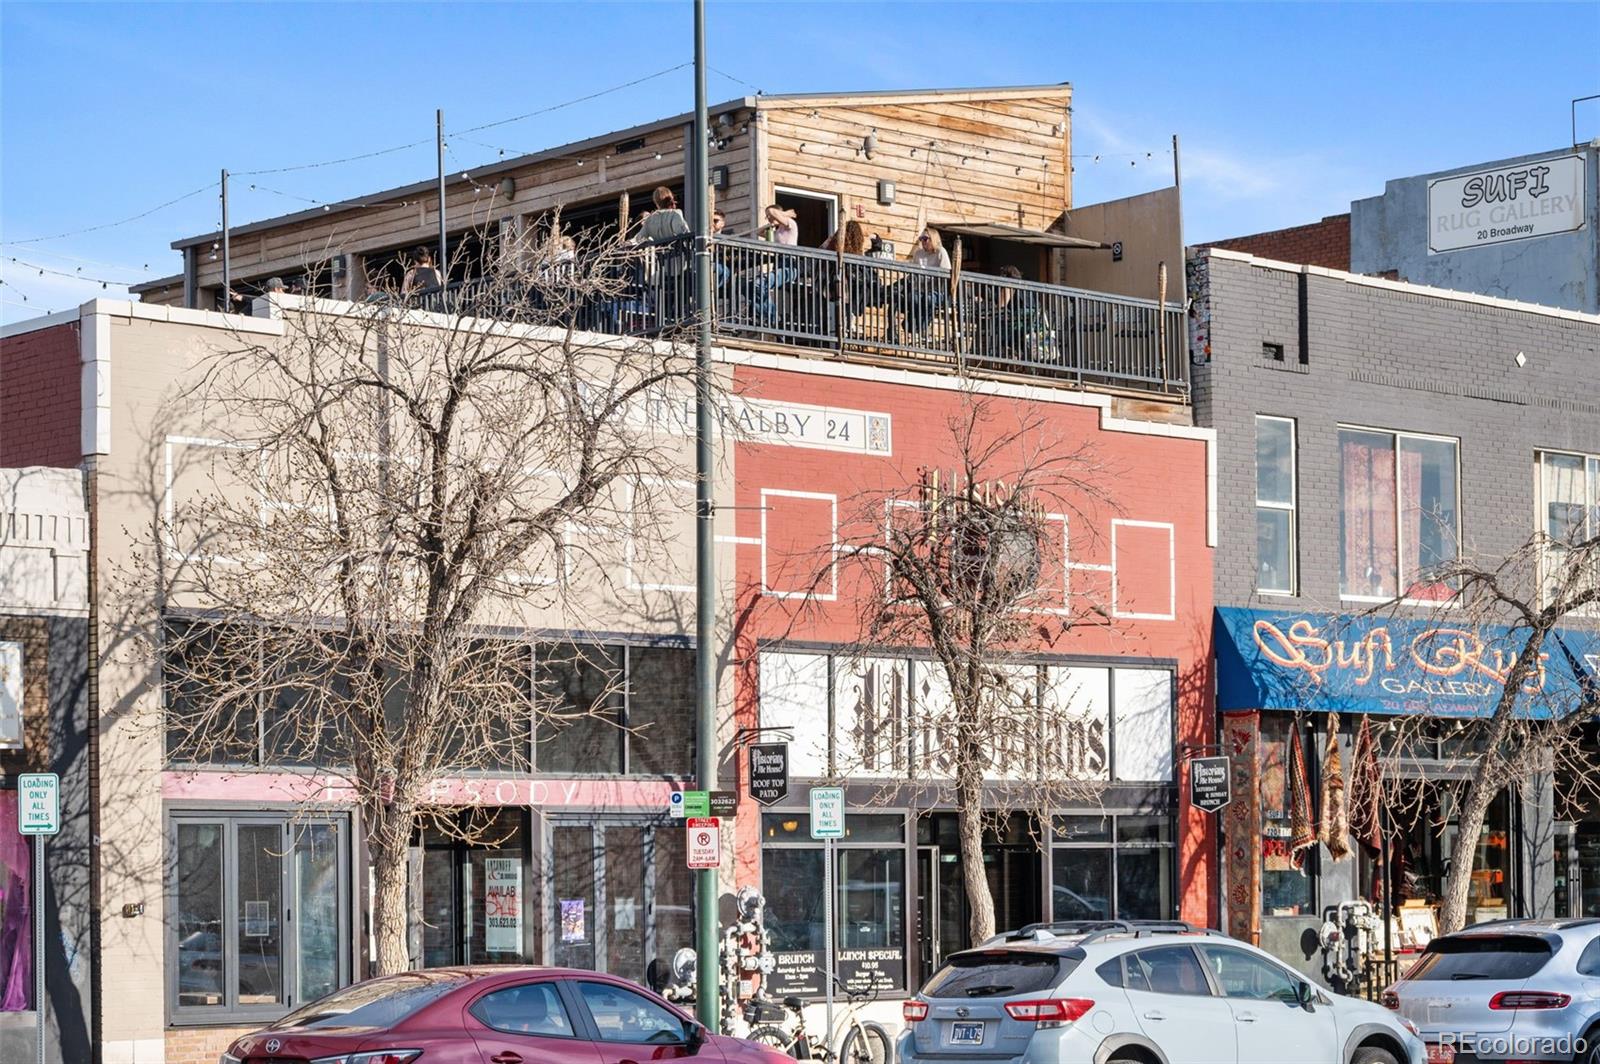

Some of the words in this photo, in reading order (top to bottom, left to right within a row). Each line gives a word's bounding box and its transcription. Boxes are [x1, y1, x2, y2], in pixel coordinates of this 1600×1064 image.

[1462, 166, 1550, 208] SUFI
[1437, 209, 1481, 233] RUG
[1489, 193, 1579, 227] GALLERY
[1477, 230, 1489, 240] 20
[1490, 223, 1535, 238] Broadway
[826, 419, 850, 442] 24
[1253, 620, 1396, 686] Sufi
[1411, 628, 1550, 694] Rug
[1381, 678, 1494, 697] GALLERY
[23, 780, 54, 788] LOADING
[753, 780, 770, 788] ROOF
[772, 779, 785, 787] TOP
[29, 791, 48, 799] ONLY
[327, 775, 576, 805] RPSODY
[759, 789, 779, 798] PATIO
[814, 792, 840, 800] LOADING
[32, 802, 45, 810] ALL
[28, 812, 50, 821] TIMES
[778, 953, 815, 964] BRUNCH
[838, 951, 866, 961] LUNCH
